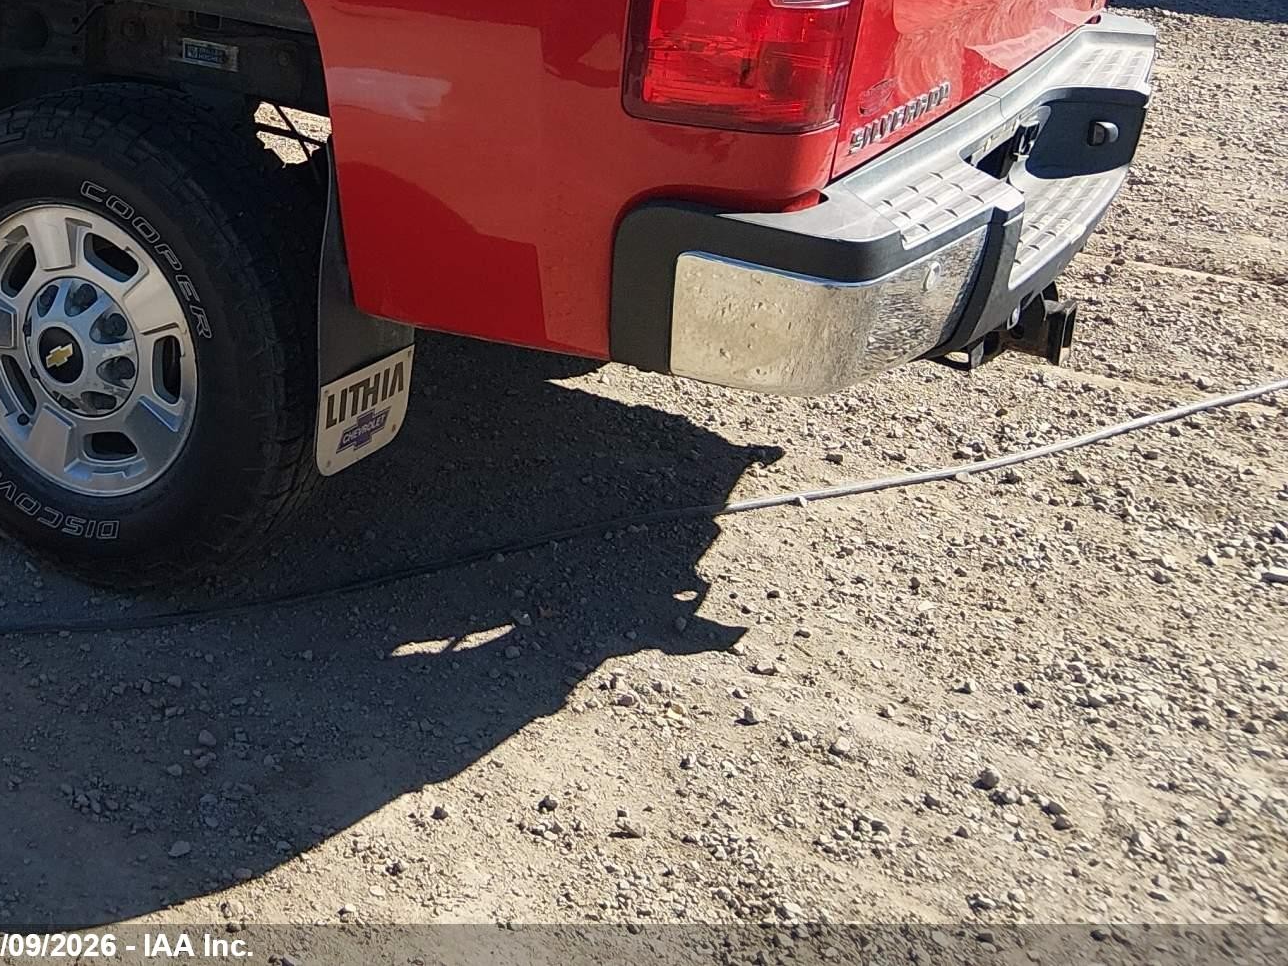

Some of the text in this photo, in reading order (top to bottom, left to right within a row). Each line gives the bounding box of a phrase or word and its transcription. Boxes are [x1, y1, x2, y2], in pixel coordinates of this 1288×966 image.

[848, 81, 950, 154] SILVERADO
[80, 180, 212, 339] COOPER
[325, 361, 404, 430] LITHIA
[342, 414, 387, 444] CHEVROLET
